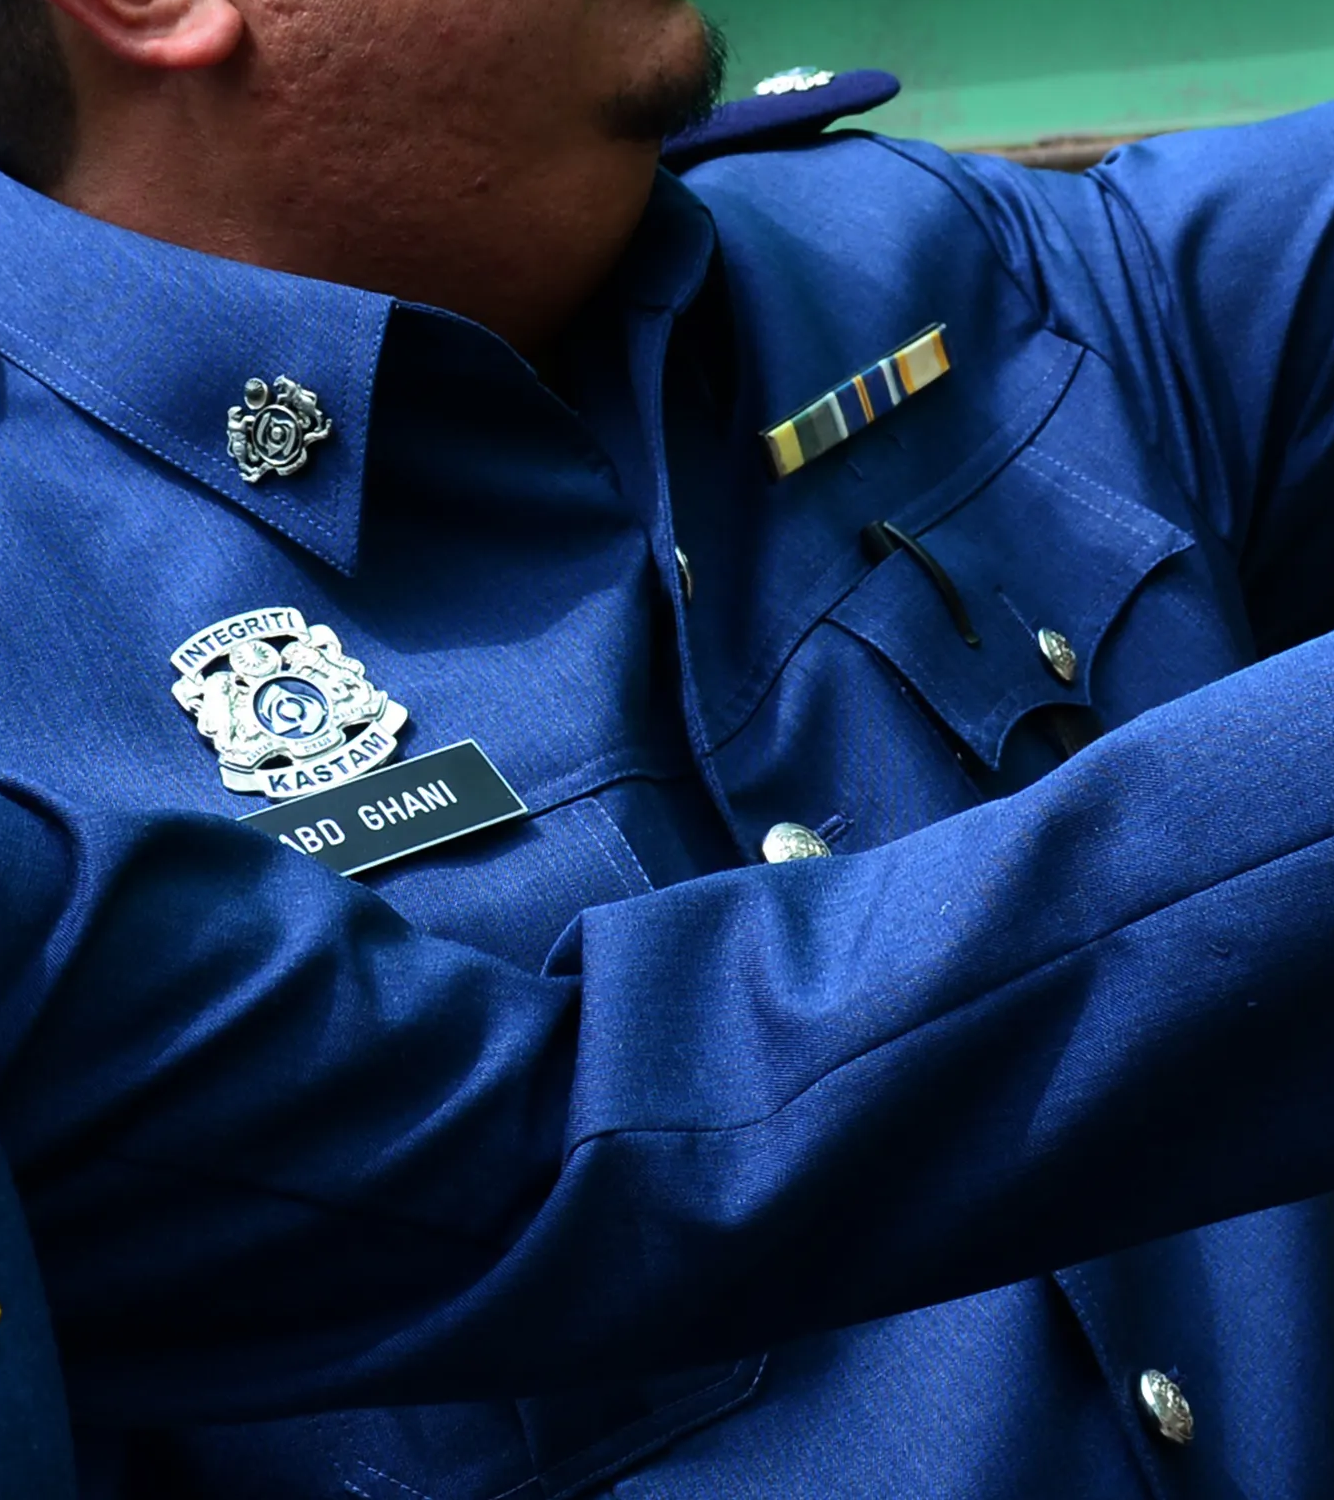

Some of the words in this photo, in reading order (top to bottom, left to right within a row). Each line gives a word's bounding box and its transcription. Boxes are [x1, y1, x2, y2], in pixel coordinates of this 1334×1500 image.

[178, 610, 294, 669] INTEGRITI
[268, 730, 389, 793] KASTAM
[357, 779, 458, 832] GHANI
